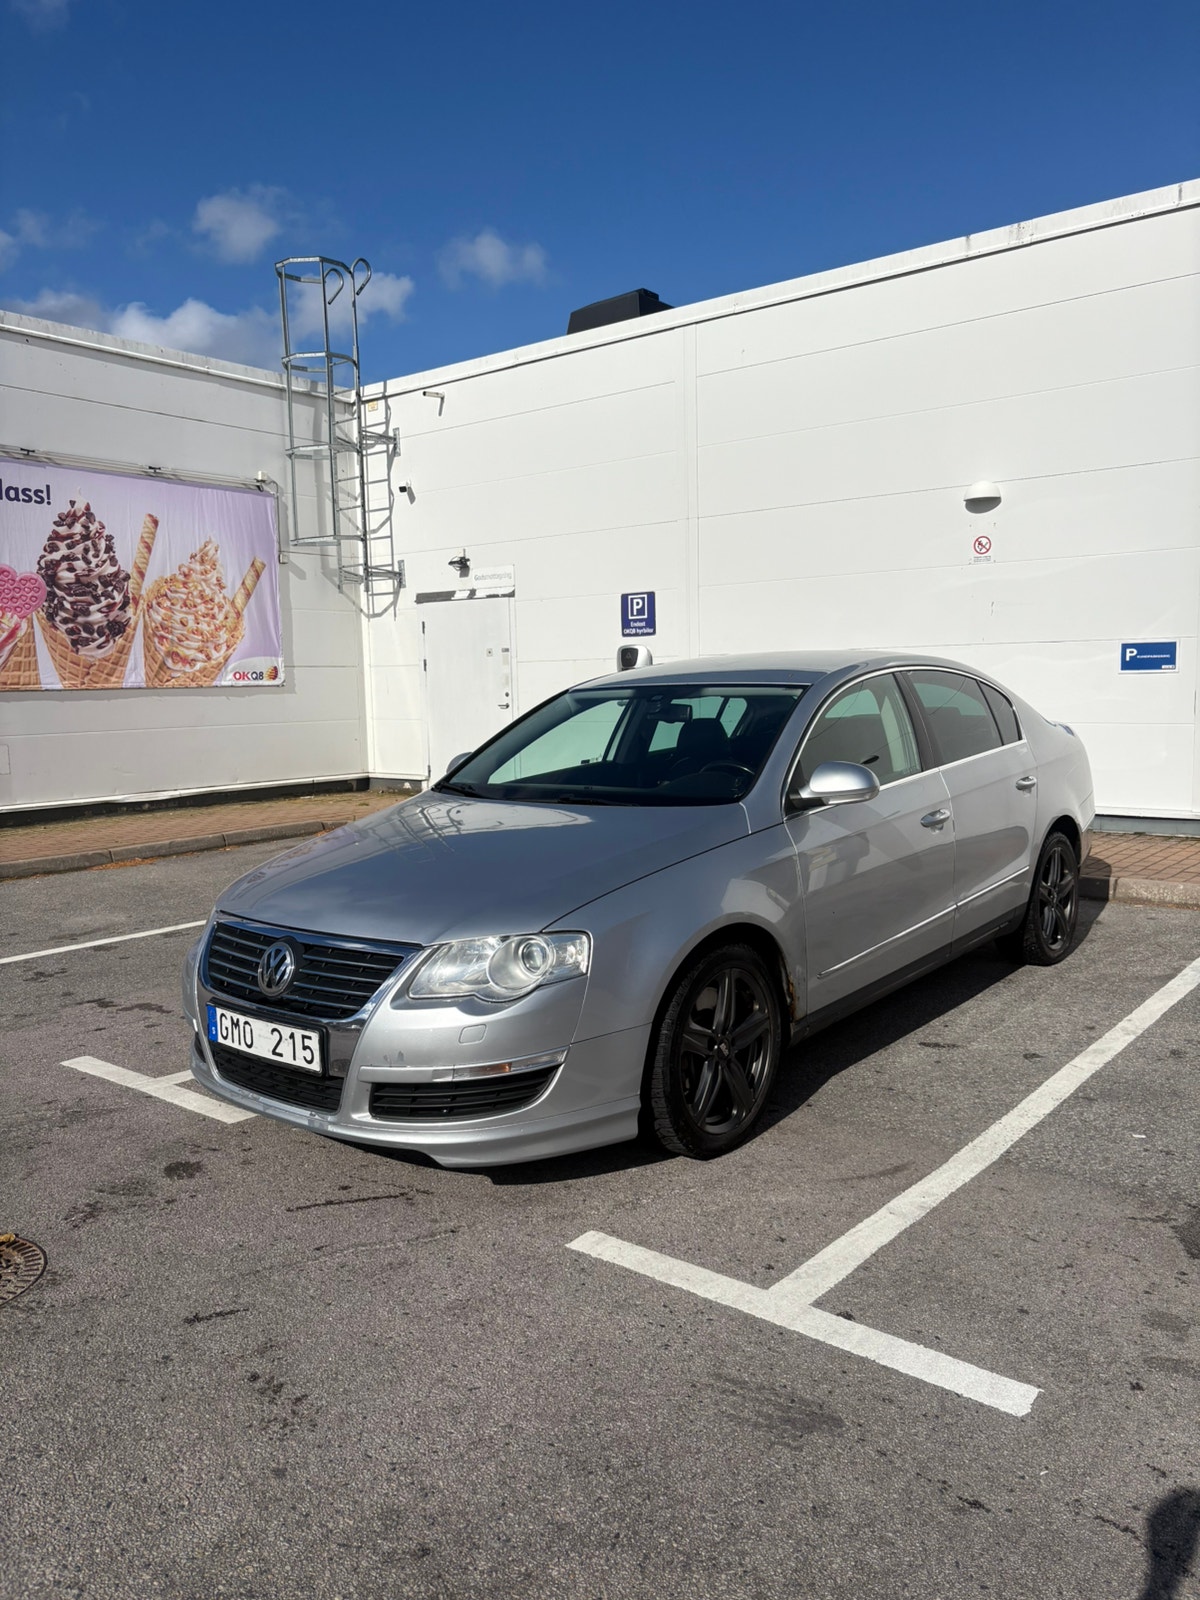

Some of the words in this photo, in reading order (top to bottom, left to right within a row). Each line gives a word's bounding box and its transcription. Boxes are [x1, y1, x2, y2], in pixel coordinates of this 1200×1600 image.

[633, 598, 643, 616] P
[1125, 648, 1138, 661] P
[233, 671, 264, 681] OKQ8
[220, 1012, 254, 1049] GMO
[270, 1027, 315, 1065] 215
